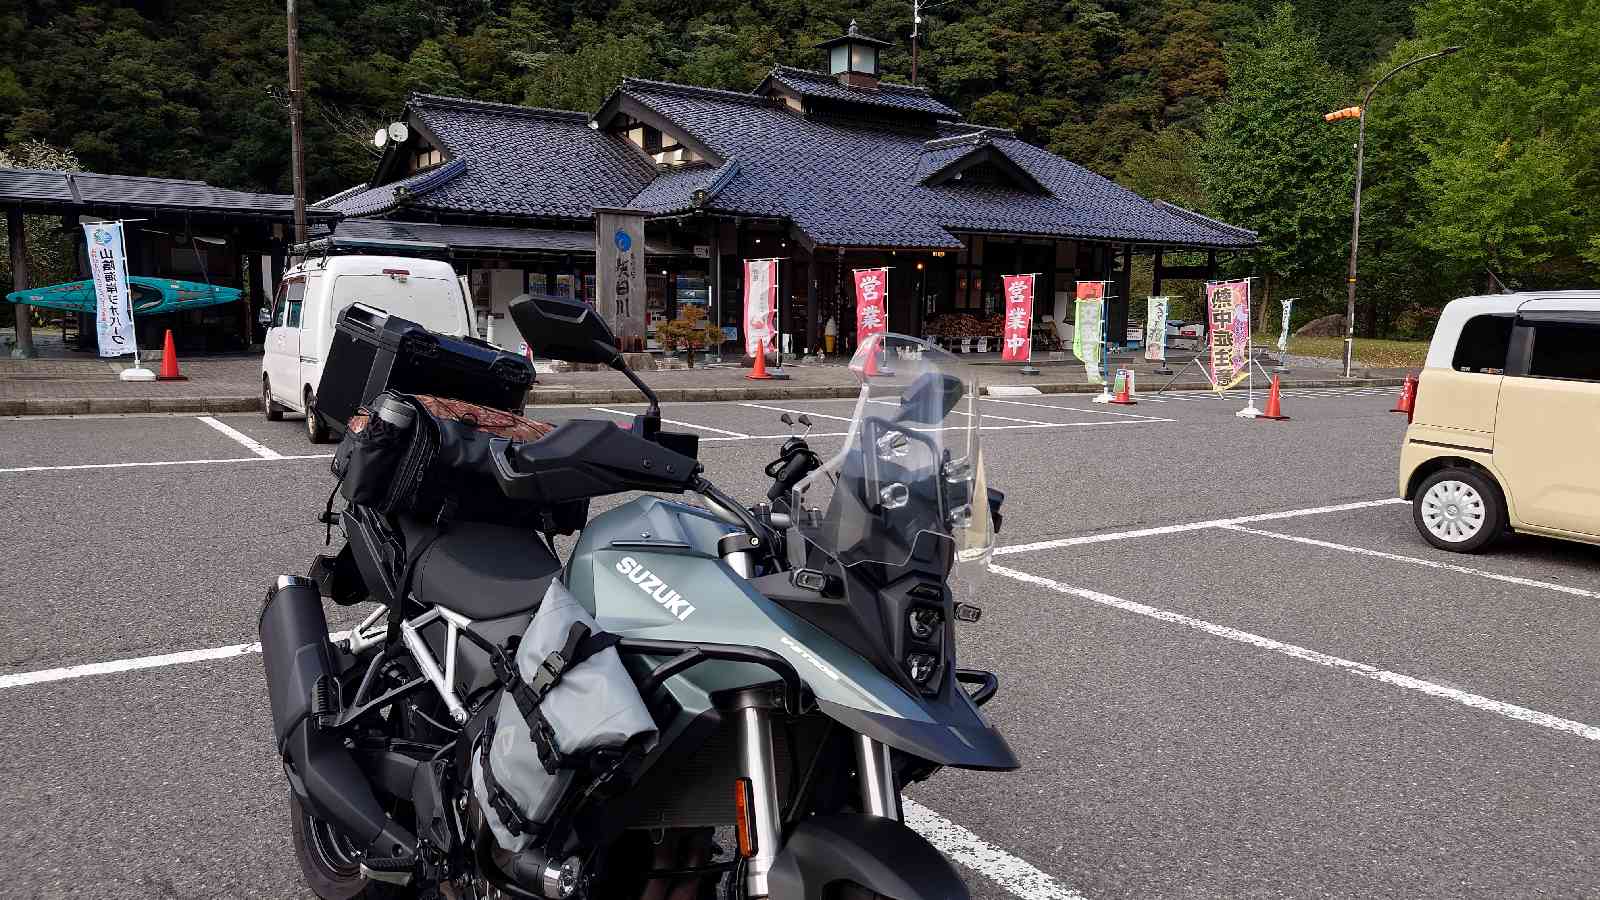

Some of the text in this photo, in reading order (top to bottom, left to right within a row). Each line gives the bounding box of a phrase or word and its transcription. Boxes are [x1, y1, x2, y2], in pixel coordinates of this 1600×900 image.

[1006, 280, 1028, 357] 営業中
[1211, 287, 1234, 387] 熱中症注意
[615, 556, 697, 622] SUZUKI
